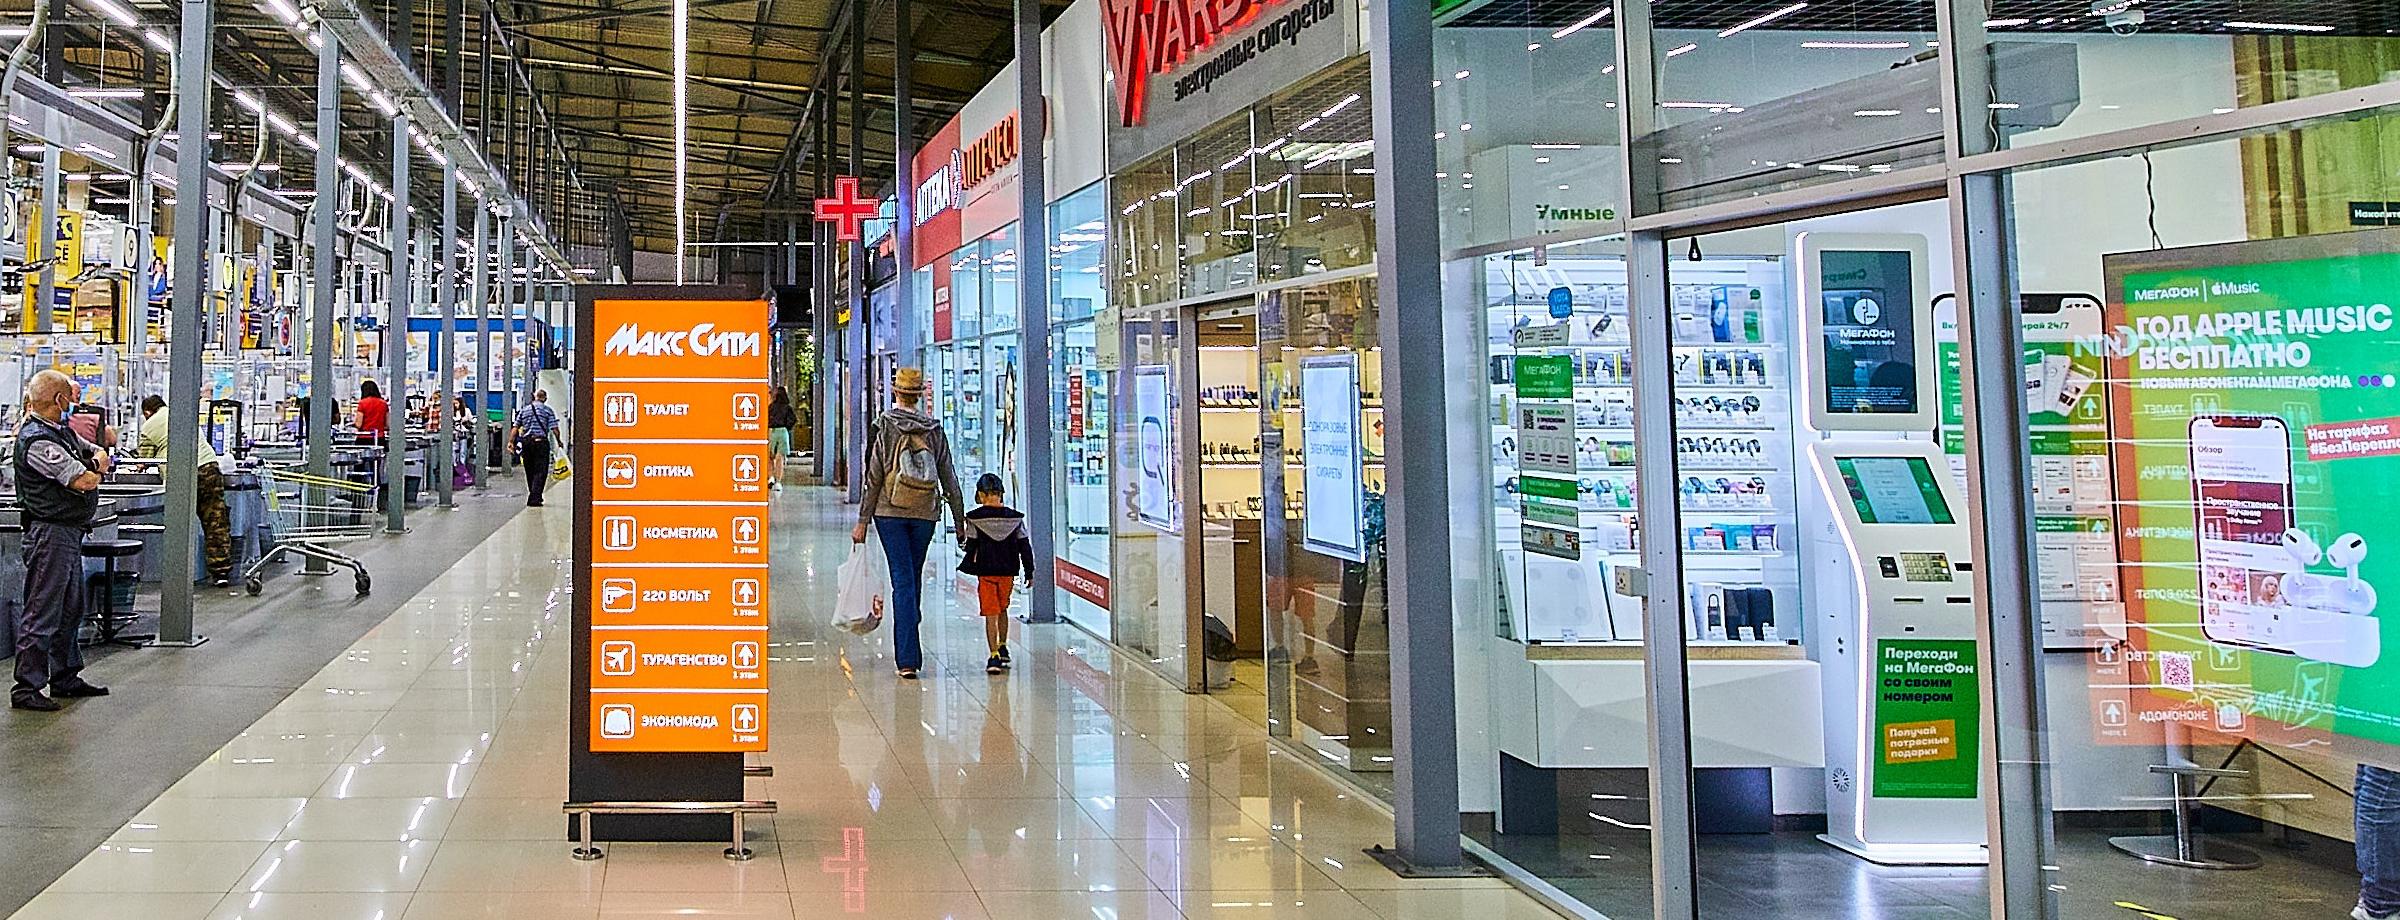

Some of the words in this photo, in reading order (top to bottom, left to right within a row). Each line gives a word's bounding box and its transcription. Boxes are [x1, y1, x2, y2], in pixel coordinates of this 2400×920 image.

[1174, 35, 1256, 101] электронные
[1257, 0, 1335, 52] сигареты
[915, 163, 951, 227] АПТЕКА
[1535, 203, 1615, 221] Умные
[2222, 281, 2260, 296] Music
[2047, 321, 2070, 330] 24/7
[2136, 314, 2193, 344] ГОД
[2195, 308, 2281, 338] APPLE
[2286, 303, 2393, 335] MUSIC
[2138, 341, 2312, 370] БЕСПЛАТНО
[2141, 376, 2190, 390] НОВЫМ
[2190, 374, 2271, 390] АБОНЕНТАМ
[2271, 374, 2352, 389] МЕГАФОНА
[643, 403, 690, 417] ТУАЛЕТ
[2307, 428, 2328, 441] На
[2327, 423, 2390, 440] тарифах
[2197, 446, 2223, 454] Обзор
[643, 465, 694, 478] ОПТИКА
[643, 527, 719, 539] КОСМЕТИКА
[642, 590, 667, 602] 220
[669, 590, 711, 602] ВОЛЬТ
[641, 654, 728, 667] ТУРАГЕНСТВО
[1885, 647, 1958, 661] Переходи
[1884, 663, 1903, 673] на
[1906, 662, 1974, 674] МегаФон
[1884, 678, 1902, 688] со
[1904, 678, 1952, 688] своим
[1884, 692, 1953, 704] номером
[641, 715, 719, 729] ЭКОНОМОДА
[1889, 726, 1937, 738] Получай
[1891, 748, 1939, 759] подарки
